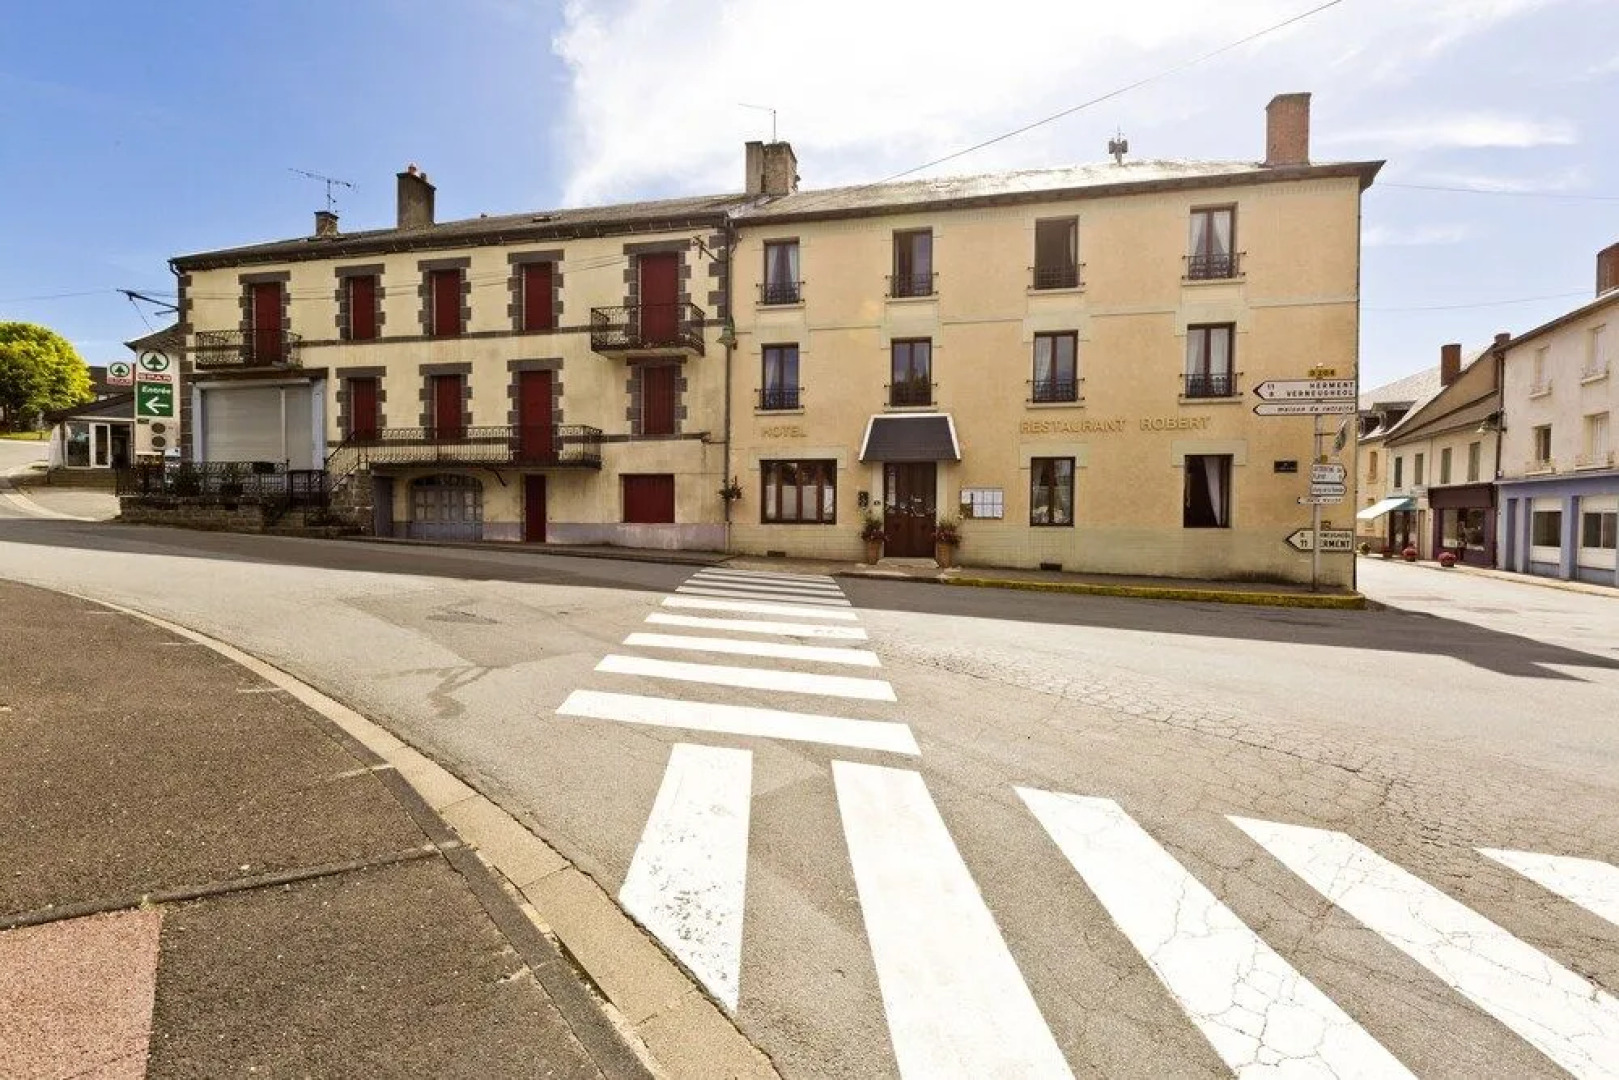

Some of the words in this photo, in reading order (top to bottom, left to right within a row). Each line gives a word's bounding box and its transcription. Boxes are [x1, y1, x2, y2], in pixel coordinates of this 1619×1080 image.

[1309, 381, 1354, 389] HERMENT
[1020, 420, 1126, 434] RESTAURANT
[1139, 416, 1211, 432] ROBERT
